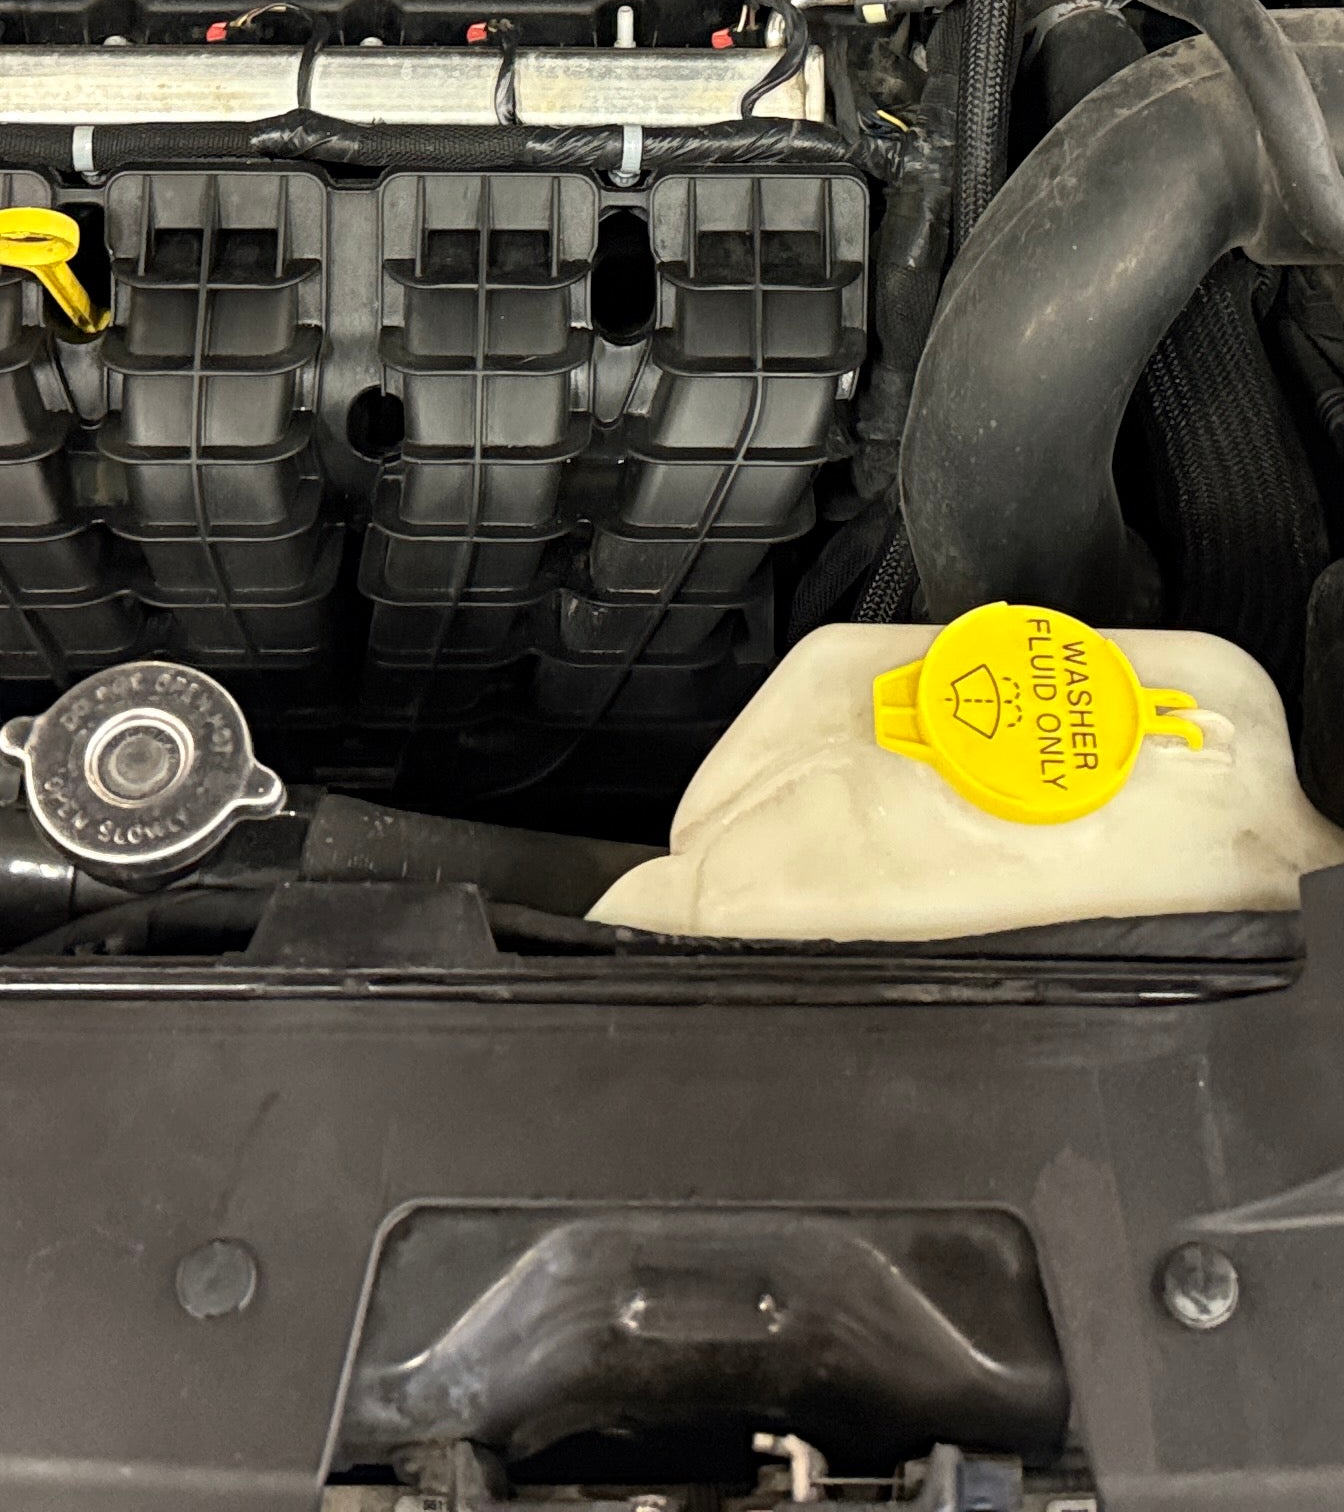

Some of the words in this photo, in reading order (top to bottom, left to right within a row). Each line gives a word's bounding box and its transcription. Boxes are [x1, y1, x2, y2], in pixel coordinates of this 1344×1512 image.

[1026, 618, 1059, 702] FLUID
[1061, 640, 1099, 771] WASHER
[1036, 712, 1069, 791] ONLY
